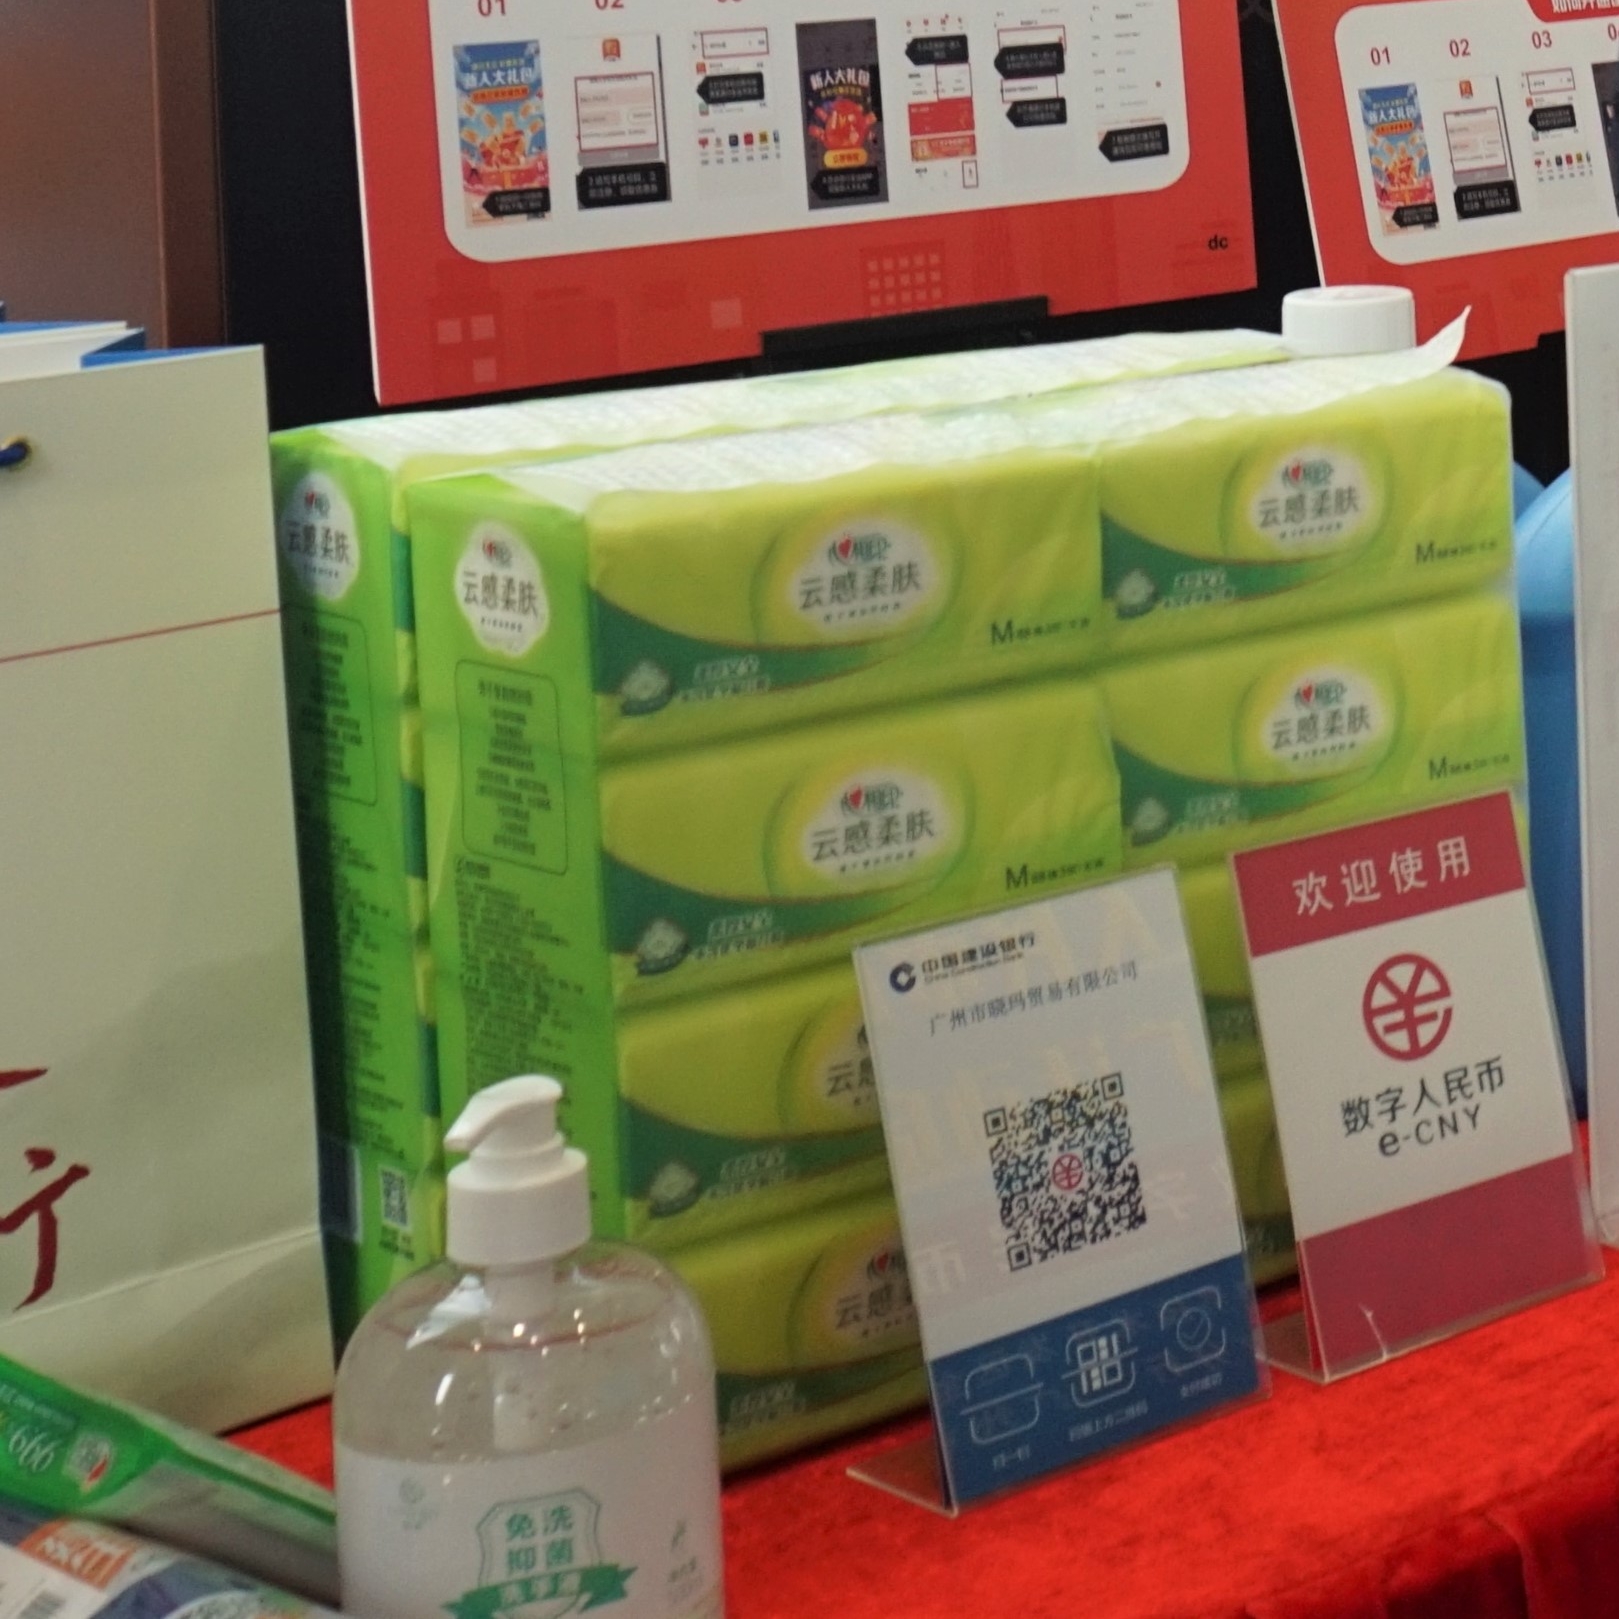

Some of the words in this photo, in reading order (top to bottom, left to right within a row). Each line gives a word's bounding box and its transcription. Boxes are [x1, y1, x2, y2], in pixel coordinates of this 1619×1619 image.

[1370, 46, 1391, 66] 01
[1449, 38, 1471, 59] 02
[1531, 30, 1553, 50] 03
[1257, 484, 1361, 532] 云感柔肤
[462, 570, 539, 620] 云感柔肤
[798, 560, 923, 611] 云感柔肤
[1271, 703, 1372, 751] 云感柔肤
[810, 808, 936, 863] 云感柔肤
[1292, 835, 1472, 917] 欢迎使用
[920, 930, 1038, 974] 中国建设银行
[1341, 1055, 1507, 1139] 数字人民币
[1377, 1103, 1485, 1158] e-CNY
[505, 1506, 574, 1543] 免洗
